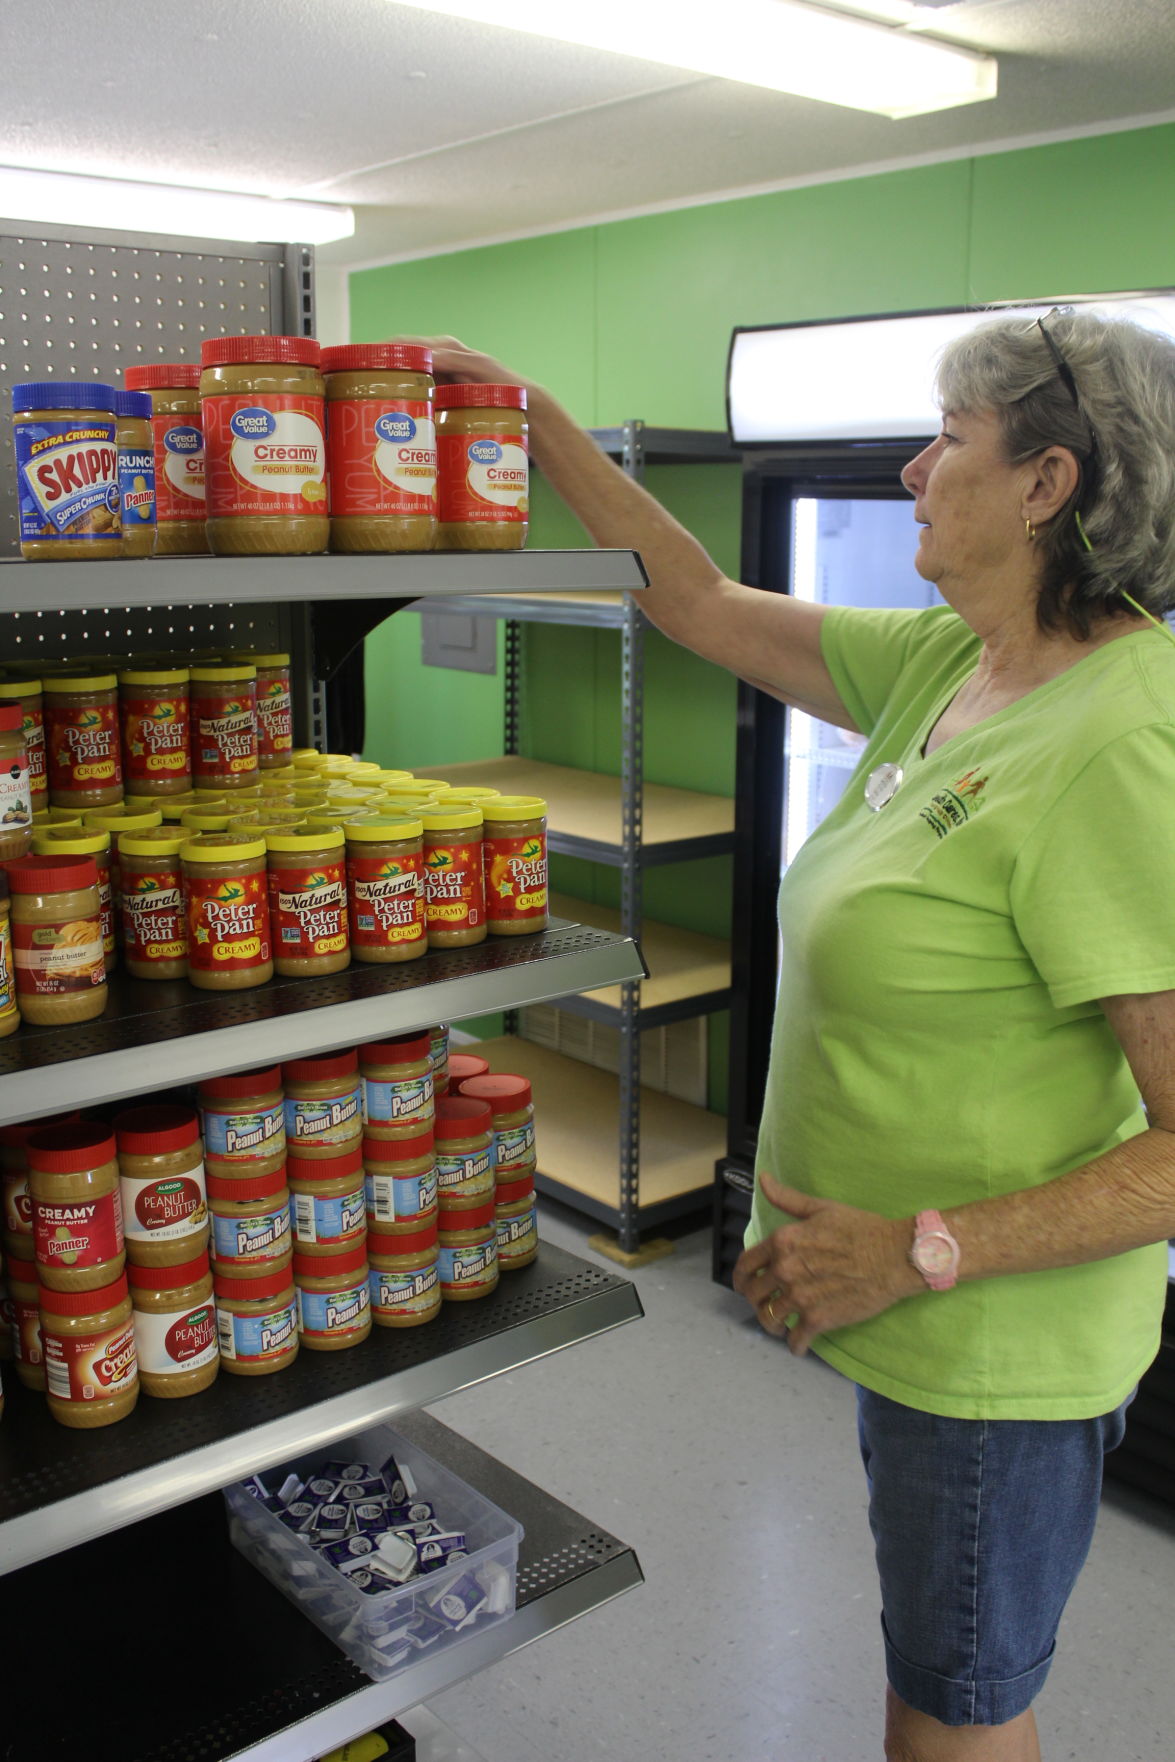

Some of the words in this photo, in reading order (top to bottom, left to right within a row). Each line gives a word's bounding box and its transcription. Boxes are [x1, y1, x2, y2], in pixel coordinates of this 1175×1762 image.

[235, 416, 268, 427] Great
[243, 425, 268, 433] Value
[381, 419, 410, 431] Great
[31, 435, 63, 455] EXTRA
[65, 430, 109, 442] CRUNCHY
[169, 433, 197, 443] Great
[254, 445, 318, 463] Creamy
[397, 448, 436, 463] Cream
[472, 446, 497, 456] Great
[118, 456, 154, 468] RUNCH
[262, 465, 293, 474] Peanut
[295, 465, 315, 474] Butter
[37, 448, 117, 501] SKIPPY
[56, 502, 81, 524] SUPER
[80, 492, 106, 509] CHUNK
[138, 720, 184, 737] Peter
[208, 711, 254, 734] Natural
[262, 713, 291, 728] Peter
[64, 728, 112, 747] Peter
[266, 723, 290, 740] Pan
[146, 736, 182, 753] Pan
[214, 733, 252, 749] Peter
[28, 750, 44, 764] ter
[72, 743, 110, 763] Pan
[150, 756, 183, 767] CREAMY
[221, 743, 251, 762] Pan
[28, 763, 43, 776] an
[77, 764, 113, 776] CREAMY
[508, 858, 547, 877] Peter
[363, 873, 416, 898] Natural
[515, 872, 546, 893] Pan
[127, 890, 178, 910] Natural
[288, 883, 340, 909] Natural
[425, 884, 462, 904] Pan
[202, 901, 257, 922] Peter
[369, 898, 416, 915] Peter
[426, 907, 464, 917] CREAMY
[130, 912, 176, 929] Peter
[295, 909, 340, 927] Peter
[377, 911, 413, 931] Pan
[137, 928, 174, 946] Pan
[211, 918, 255, 941] Pan
[303, 921, 339, 942] Pan
[391, 927, 421, 939] CREAMY
[149, 944, 185, 954] CREAMY
[217, 942, 257, 955] CREAMY
[317, 938, 345, 951] CREAMY
[40, 955, 64, 963] peanut
[66, 951, 87, 960] butter
[391, 1091, 425, 1119] Peanut
[295, 1115, 331, 1137] Peanut
[331, 1098, 358, 1126] Butter
[226, 1129, 264, 1153] Peanut
[498, 1139, 526, 1164] Peanut
[465, 1154, 489, 1179] Butter
[158, 1182, 181, 1191] ALGOOD
[144, 1192, 184, 1208] PEANUT
[165, 1199, 197, 1218] BUTTER
[38, 1205, 96, 1220] CREAMY
[48, 1237, 89, 1255] Panner
[237, 1230, 274, 1255] Peanut
[454, 1257, 485, 1281] Peanut
[380, 1284, 414, 1305] Peanut
[327, 1304, 360, 1329] Peanut
[176, 1319, 209, 1342] PEANUT
[261, 1319, 292, 1351] Peanut
